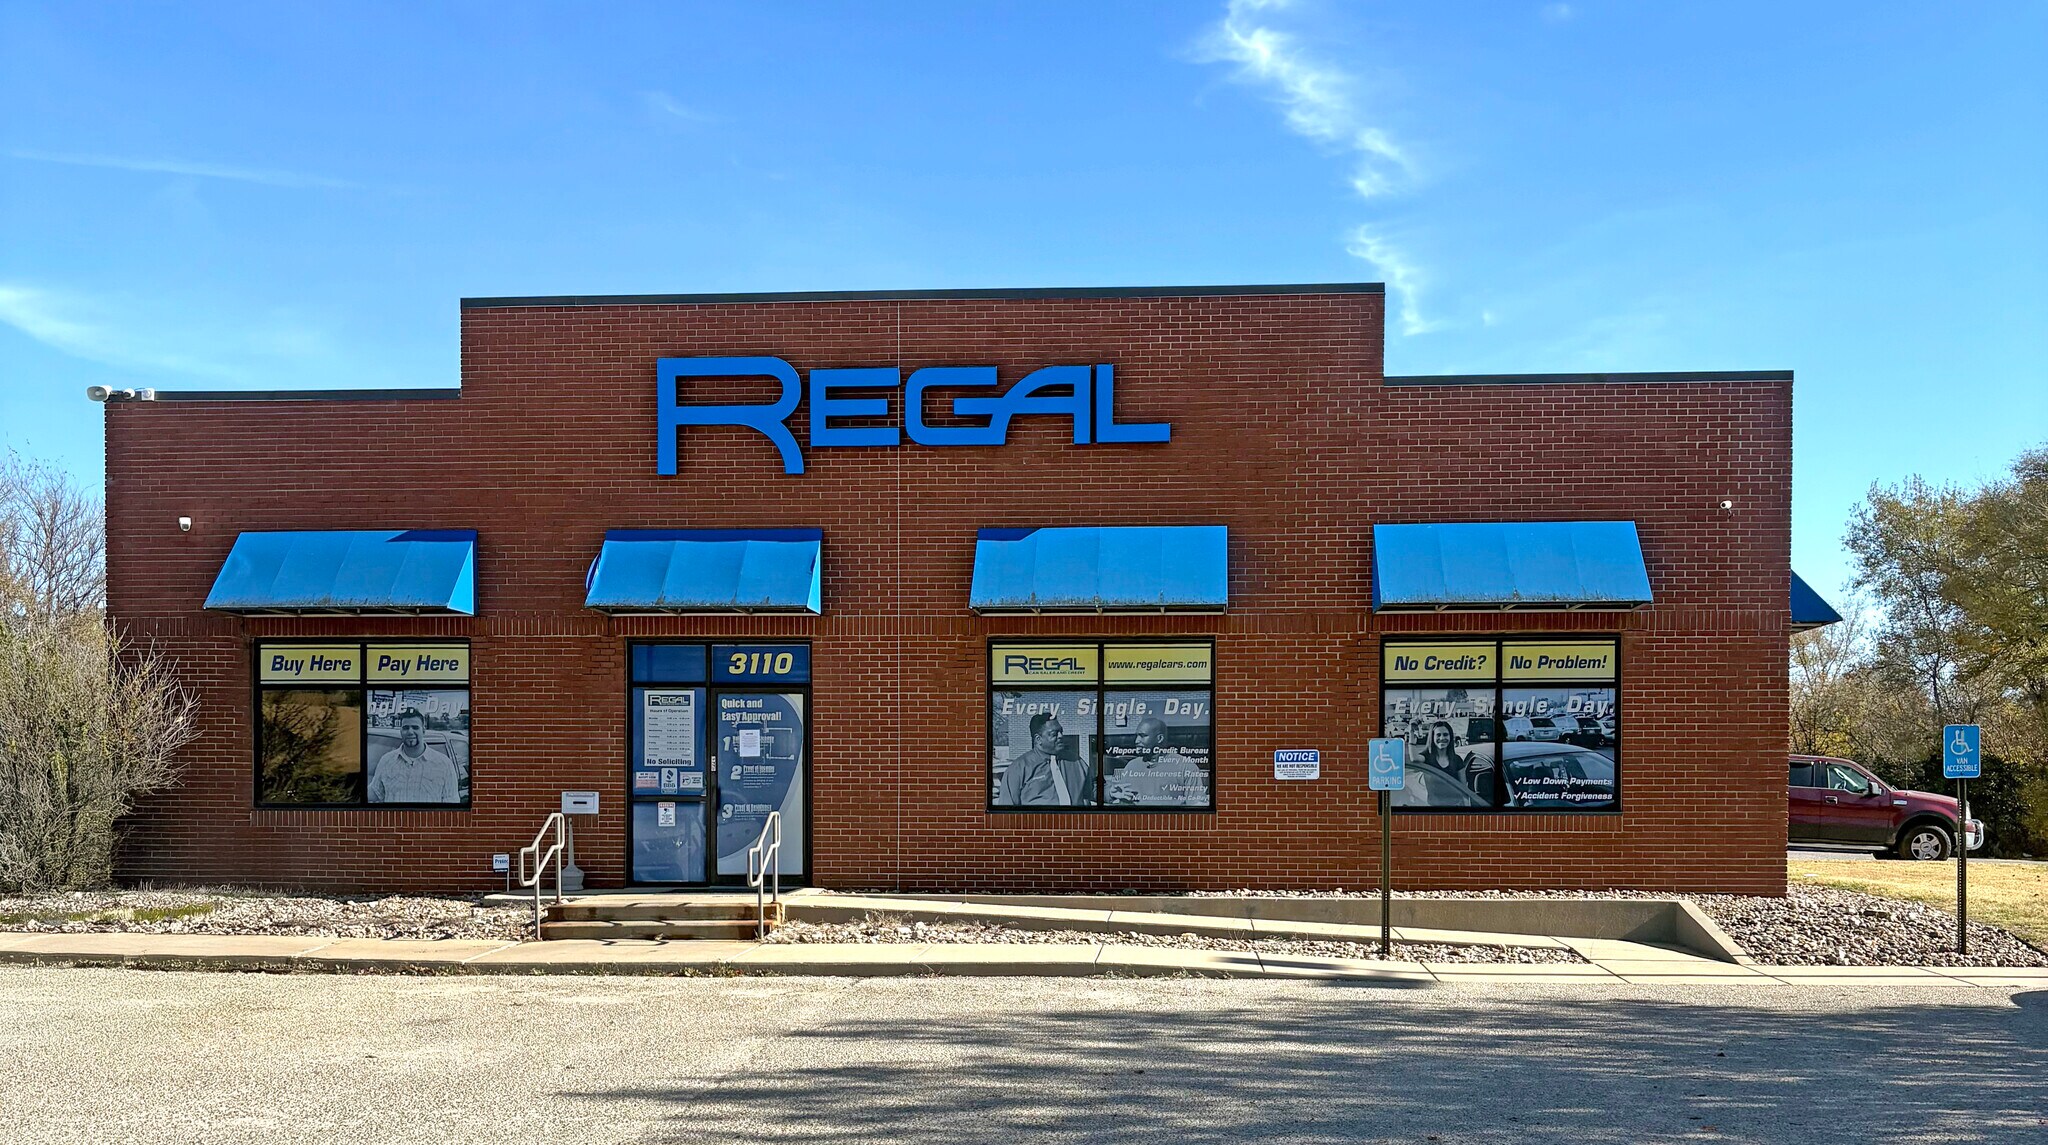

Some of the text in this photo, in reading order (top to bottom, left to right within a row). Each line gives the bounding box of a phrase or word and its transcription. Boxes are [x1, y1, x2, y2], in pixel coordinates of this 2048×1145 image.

[657, 356, 1171, 475] REGAL
[271, 655, 352, 675] Buy Here
[378, 655, 459, 675] Pay Here
[728, 652, 794, 675] 3110
[1005, 655, 1086, 674] REGAL
[1108, 659, 1208, 671] www.regalcars.com
[1394, 655, 1487, 671] No Credit?
[1510, 655, 1608, 669] No Problem!
[649, 695, 689, 706] REGAL
[721, 699, 763, 709] Quick and
[1567, 695, 1614, 718] Day.
[1001, 698, 1065, 720] Every.
[1164, 699, 1210, 719] Day.
[721, 712, 782, 722] Easy Approval!
[723, 736, 731, 751] 1
[1112, 747, 1140, 755] Report
[1278, 752, 1316, 761] NOTICE
[658, 758, 692, 766] Soliciting
[1158, 756, 1181, 764] Every
[730, 765, 743, 780] 2
[1946, 764, 1978, 772] ACCESSIBLE
[1372, 776, 1402, 785] PARKING
[1523, 777, 1613, 787] Low Down Payments
[1169, 784, 1208, 793] Warranty
[1561, 792, 1613, 801] Forgiveness
[722, 804, 734, 819] 3
